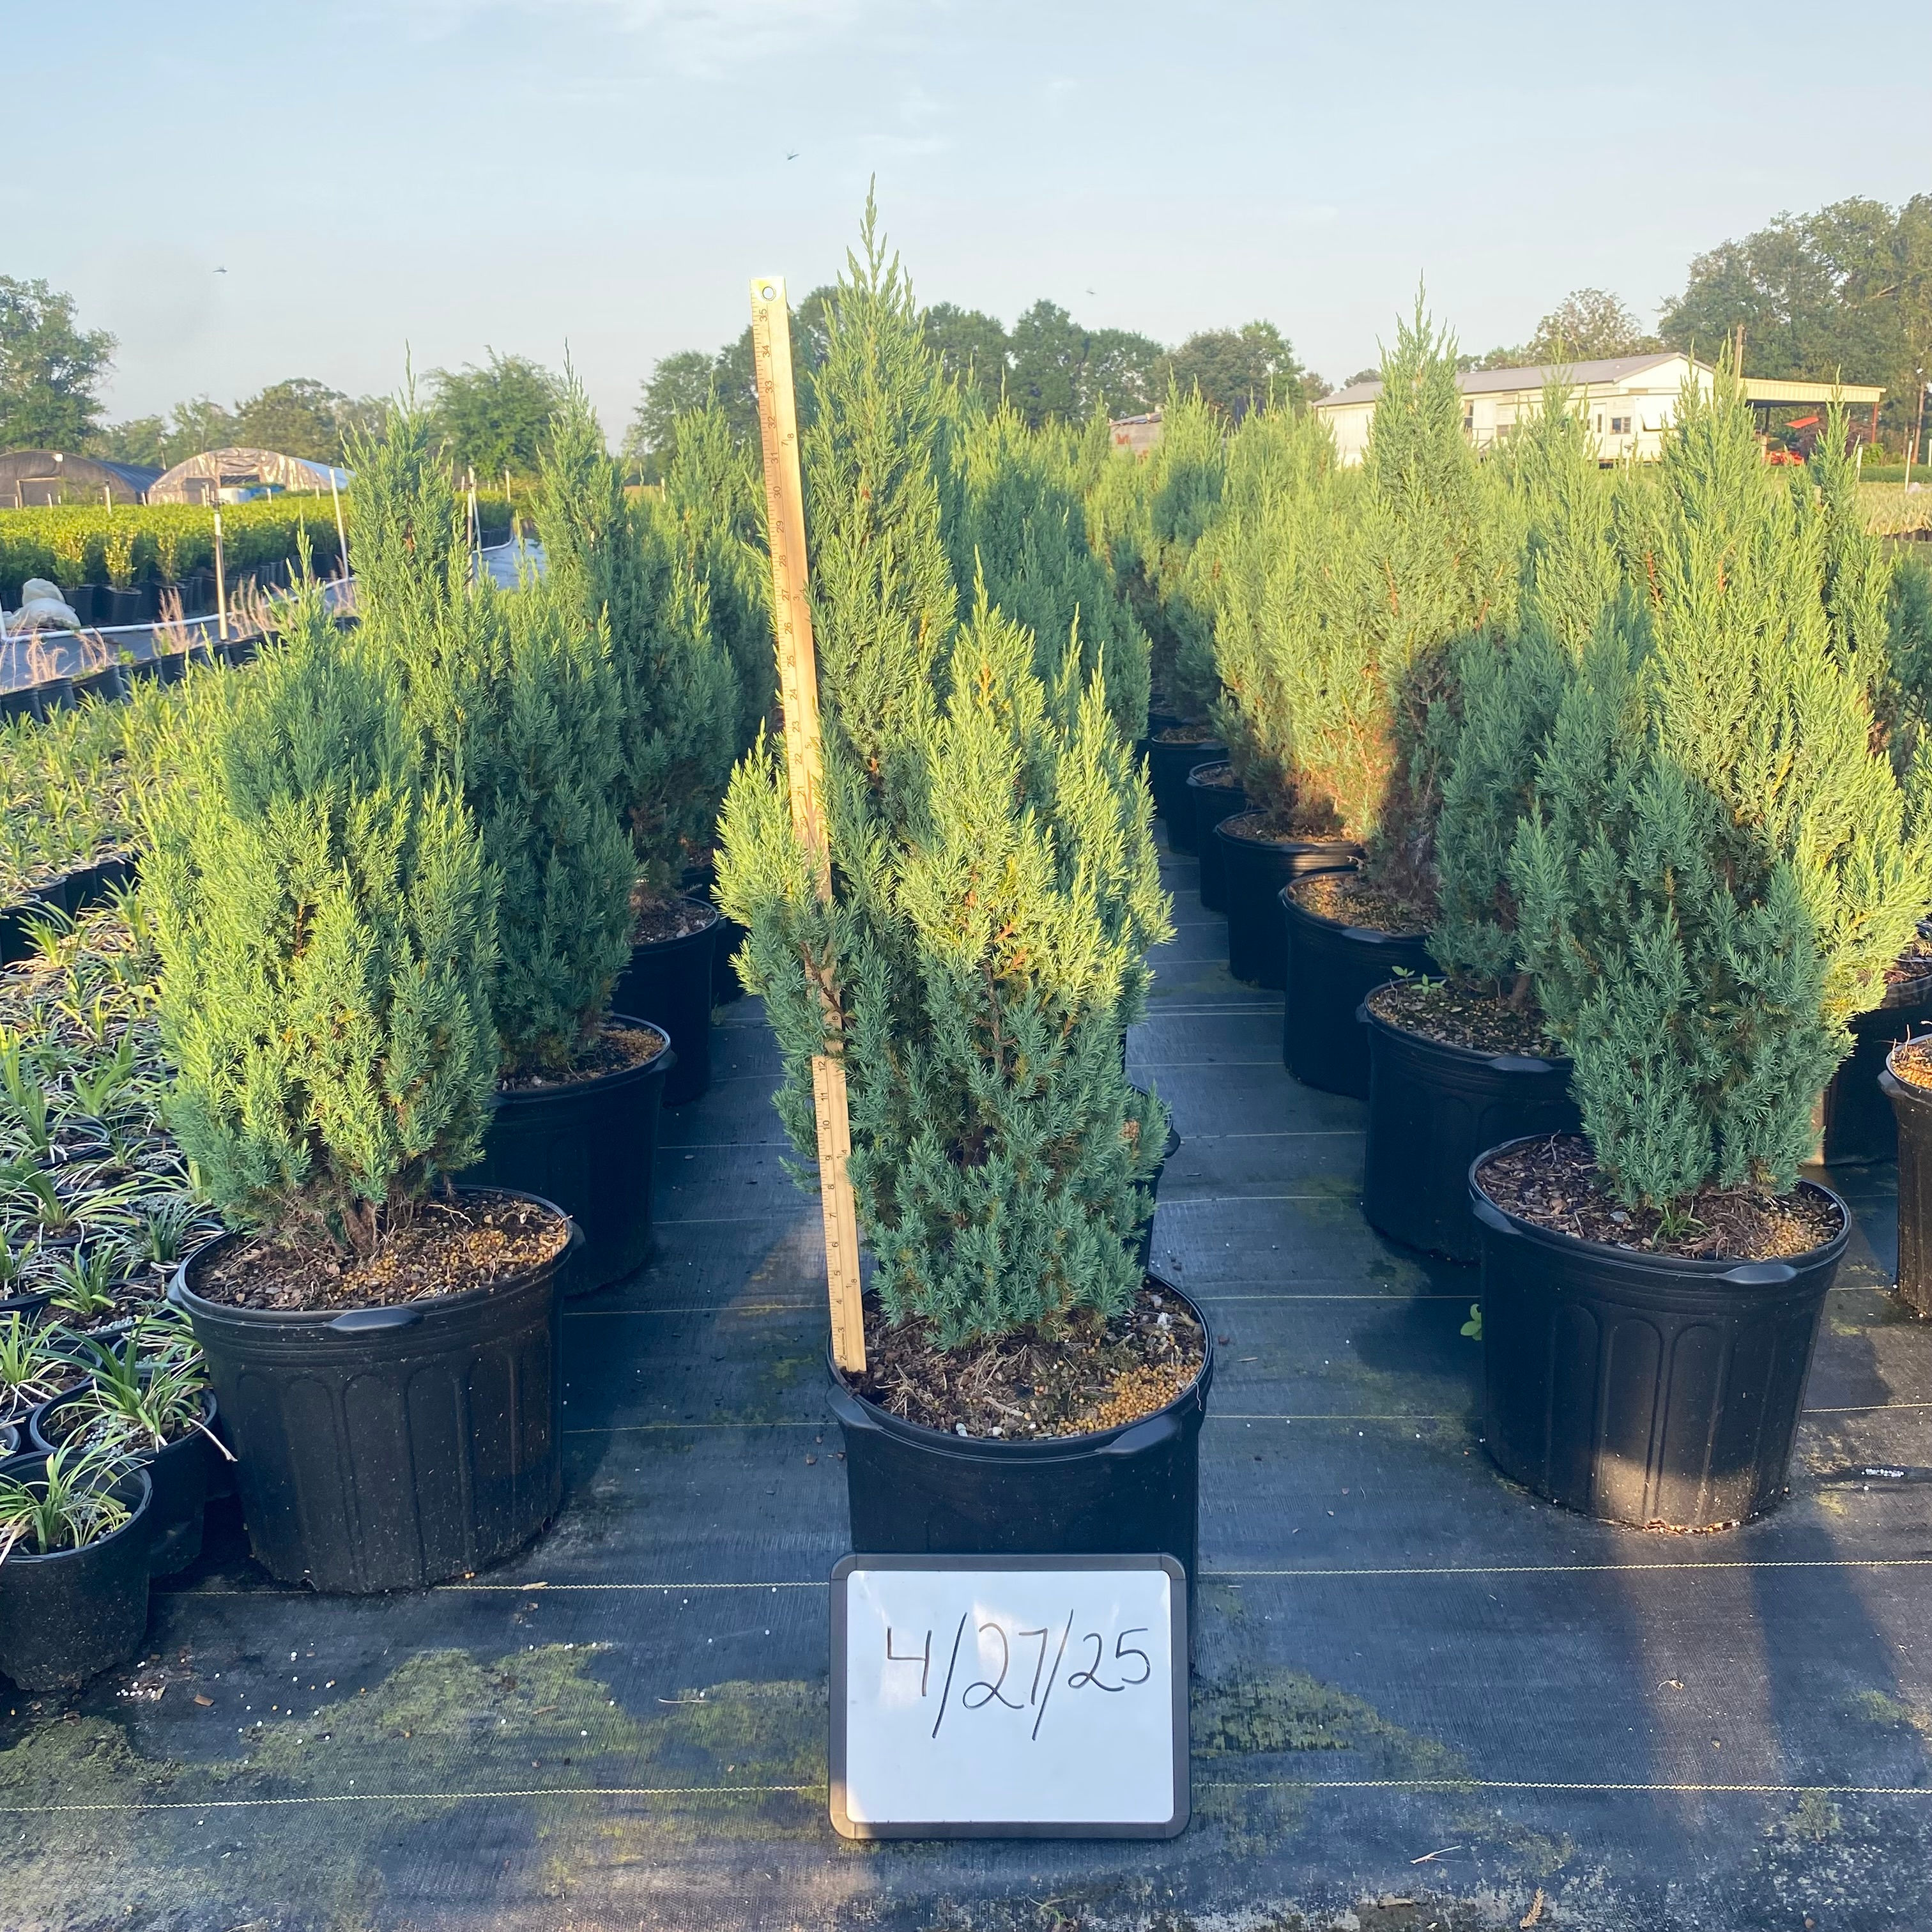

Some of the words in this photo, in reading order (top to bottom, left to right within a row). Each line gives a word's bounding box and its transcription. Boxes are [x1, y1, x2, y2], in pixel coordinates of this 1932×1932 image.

[759, 309, 767, 321] 35
[762, 345, 770, 358] 34
[765, 380, 774, 394] 33
[768, 416, 776, 429] 32
[771, 453, 779, 464] 31
[773, 486, 781, 499] 30
[776, 521, 784, 533] 29
[779, 555, 787, 567] 28
[782, 589, 790, 601] 27
[785, 622, 792, 634] 26
[787, 655, 795, 667] 25
[790, 689, 797, 700] 24
[792, 721, 800, 733] 23
[795, 753, 802, 765] 22
[797, 786, 805, 797] 21
[800, 816, 807, 828] 20
[818, 1061, 825, 1071] 12
[821, 1092, 828, 1101] 11
[823, 1120, 830, 1130] 10
[887, 1609, 1151, 1741] 4/27/25
